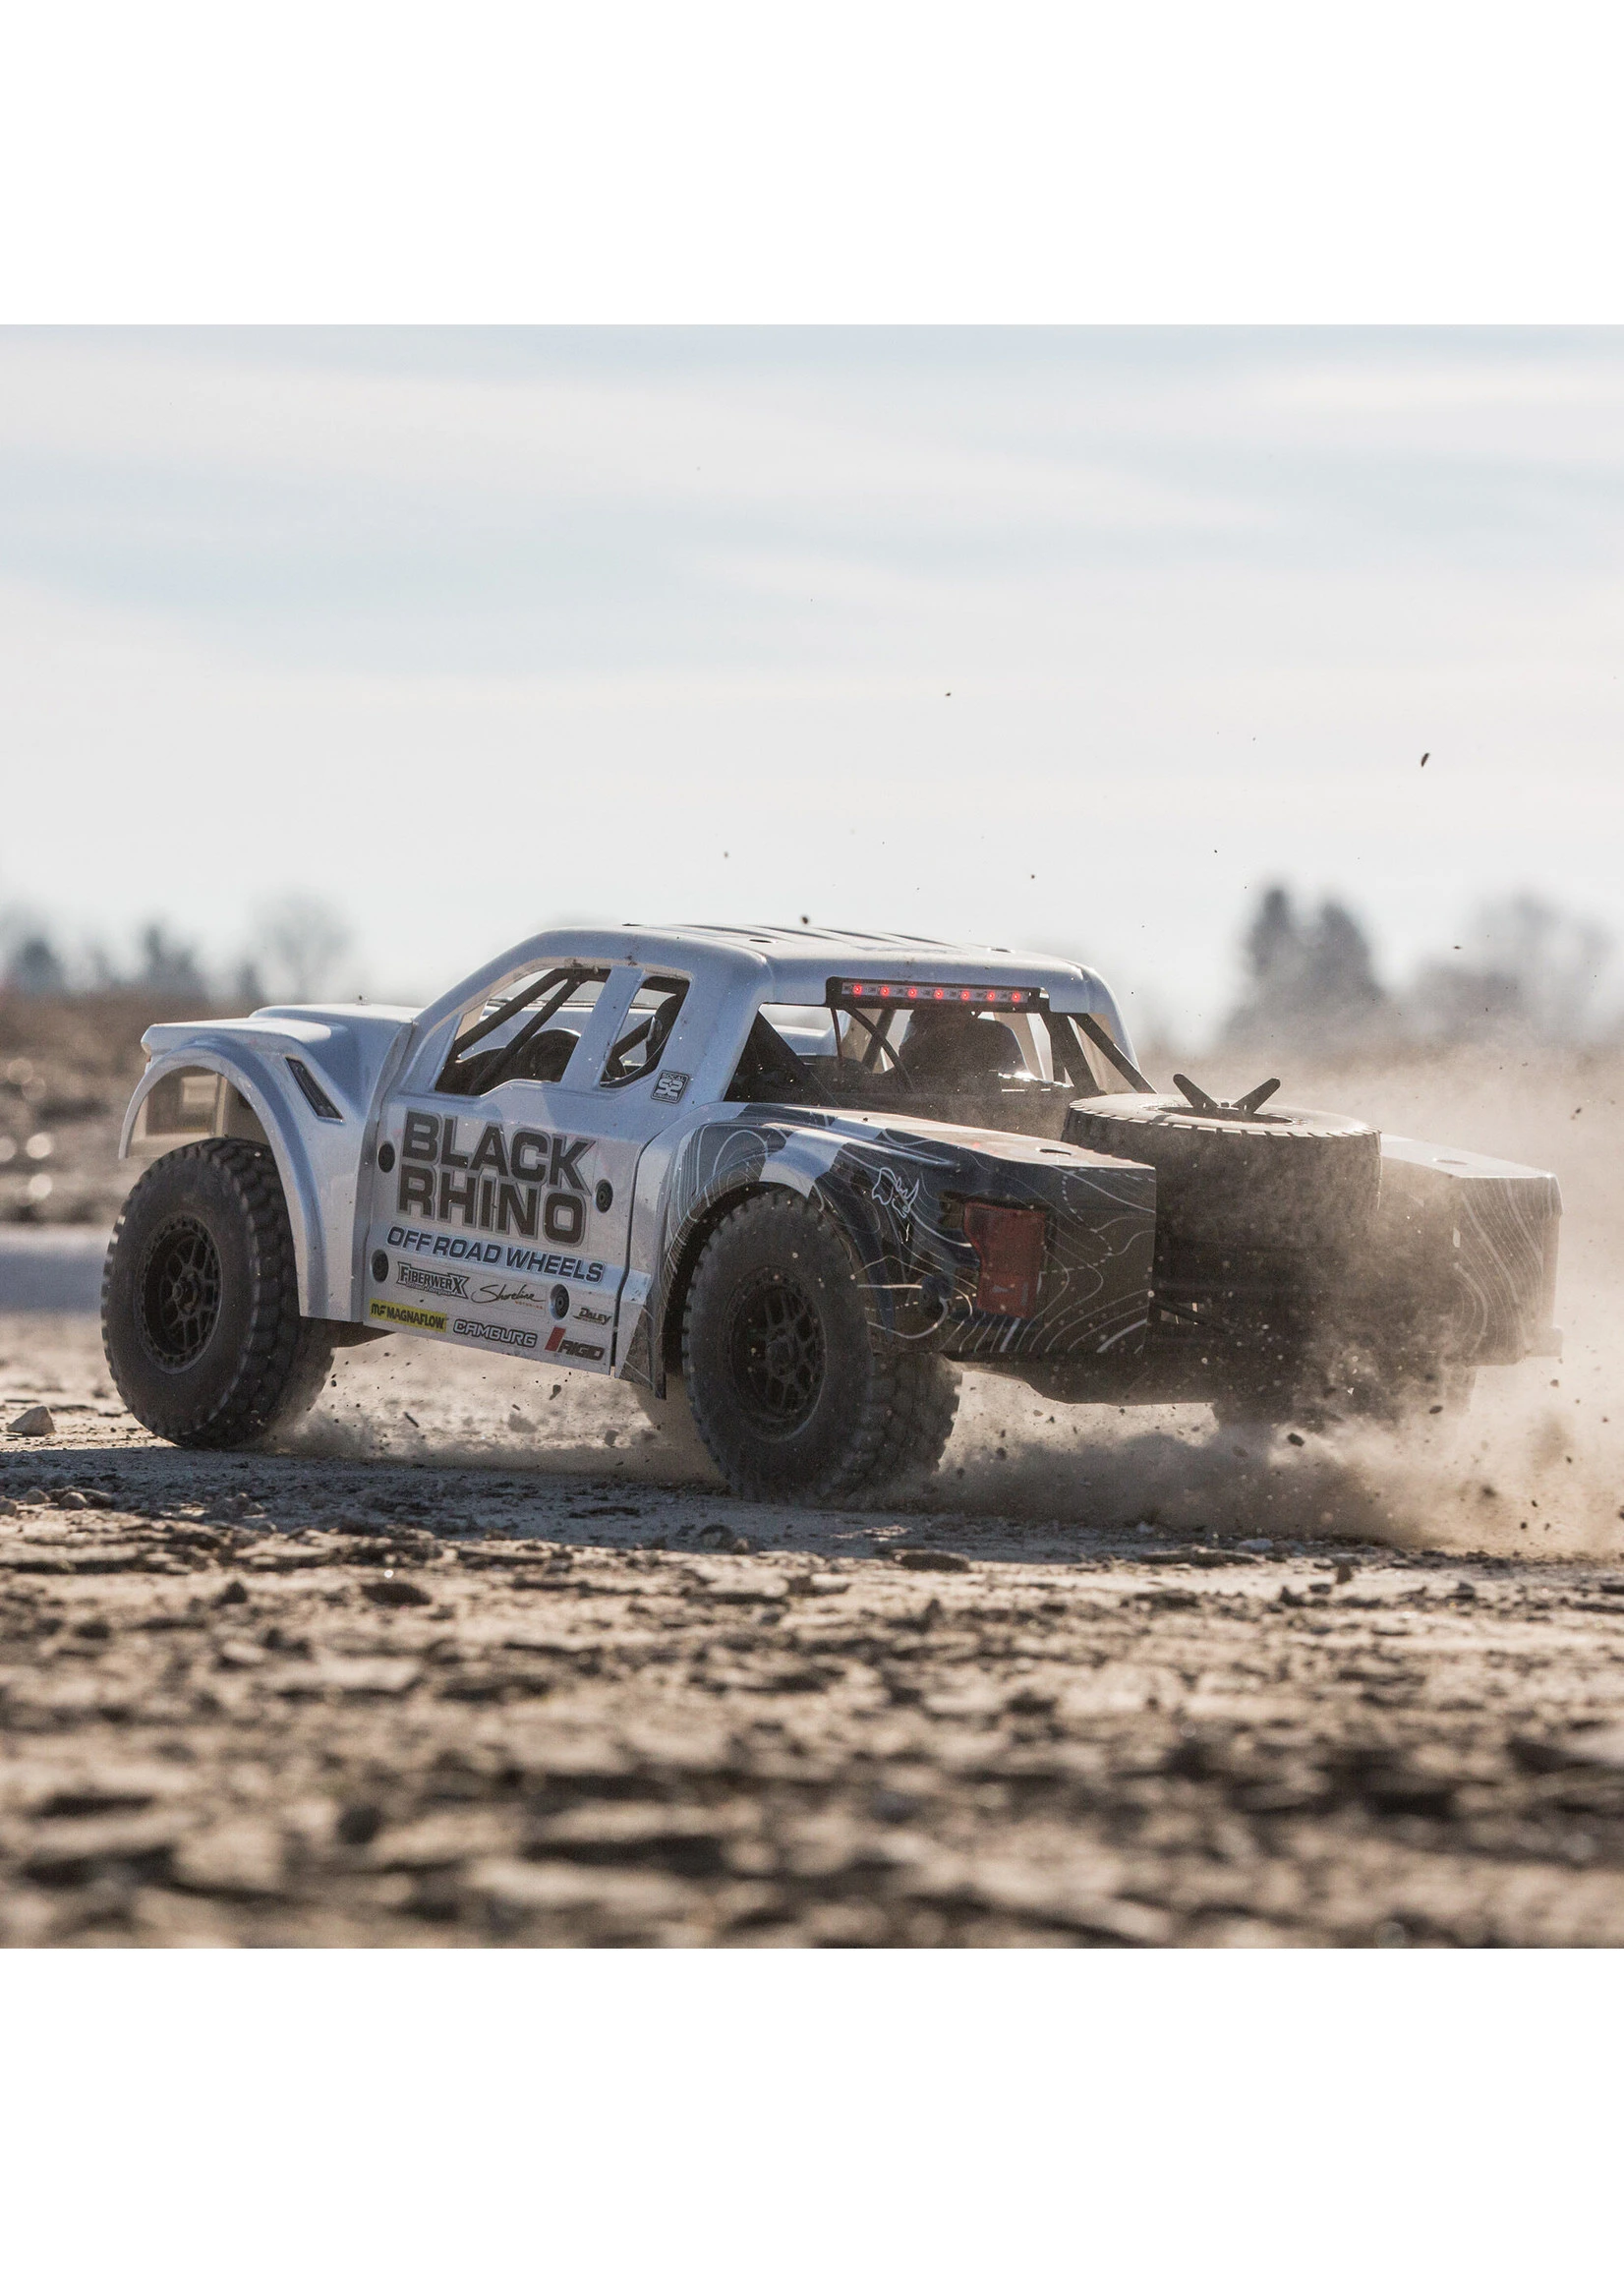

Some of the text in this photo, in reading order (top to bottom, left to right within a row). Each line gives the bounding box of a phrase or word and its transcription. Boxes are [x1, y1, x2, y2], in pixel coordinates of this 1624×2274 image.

[401, 1108, 596, 1195] BLACK
[397, 1164, 587, 1247] RHINO
[387, 1226, 604, 1282] OFF ROAD WHEELS
[471, 1284, 546, 1304] Shoreline
[386, 1306, 445, 1330] MAGNAFLOW
[454, 1319, 537, 1347] CAMBURG
[557, 1339, 606, 1361] RIGID
